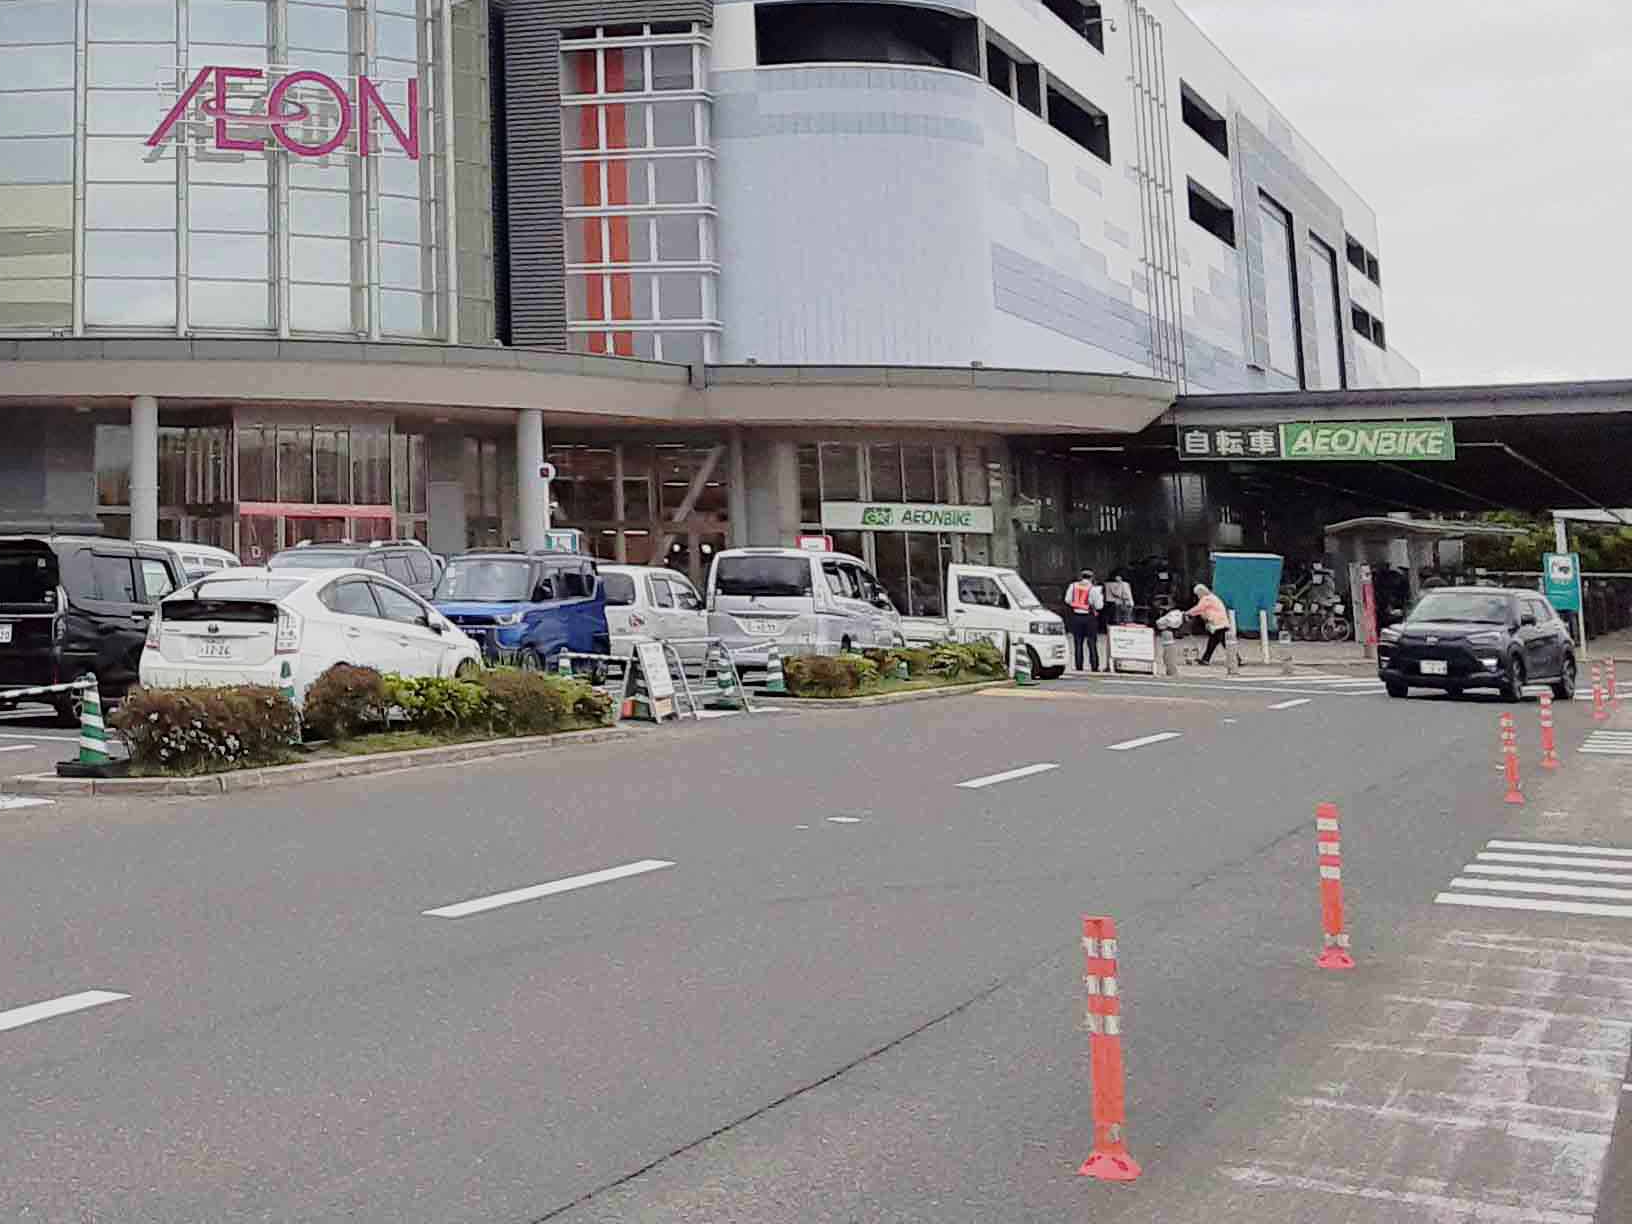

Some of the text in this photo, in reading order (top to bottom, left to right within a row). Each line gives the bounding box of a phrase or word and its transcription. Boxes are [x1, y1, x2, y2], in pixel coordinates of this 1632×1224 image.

[1183, 430, 1277, 456] 自転車
[1291, 428, 1445, 456] AEONBIKE
[901, 509, 972, 527] AEONBIKE
